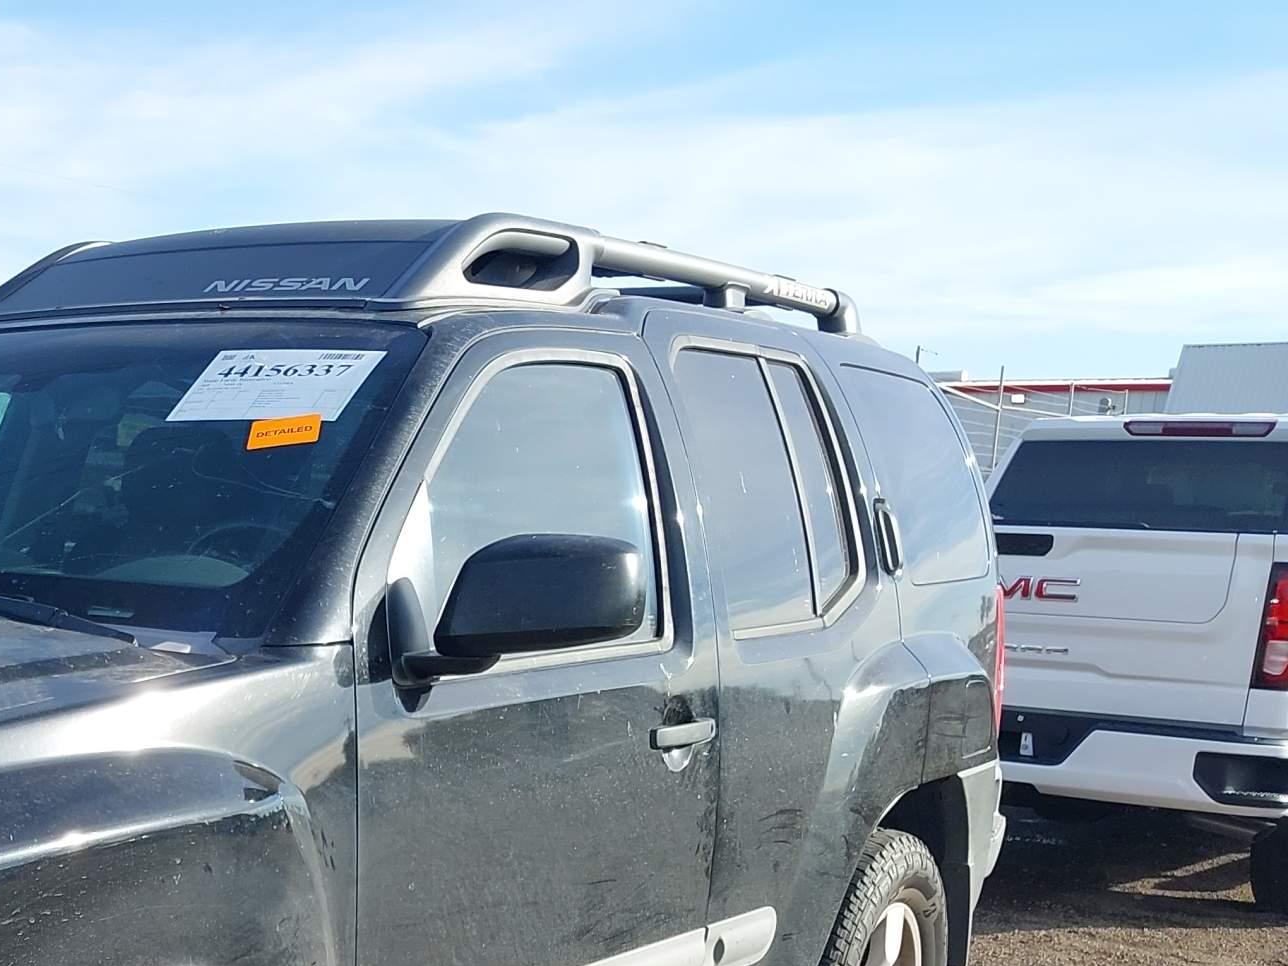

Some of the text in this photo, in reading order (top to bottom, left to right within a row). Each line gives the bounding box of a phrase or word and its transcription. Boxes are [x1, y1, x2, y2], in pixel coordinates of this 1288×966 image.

[203, 277, 371, 293] NISSAN
[217, 364, 353, 378] 44156337
[256, 425, 312, 438] DETAILED
[999, 575, 1081, 603] MC
